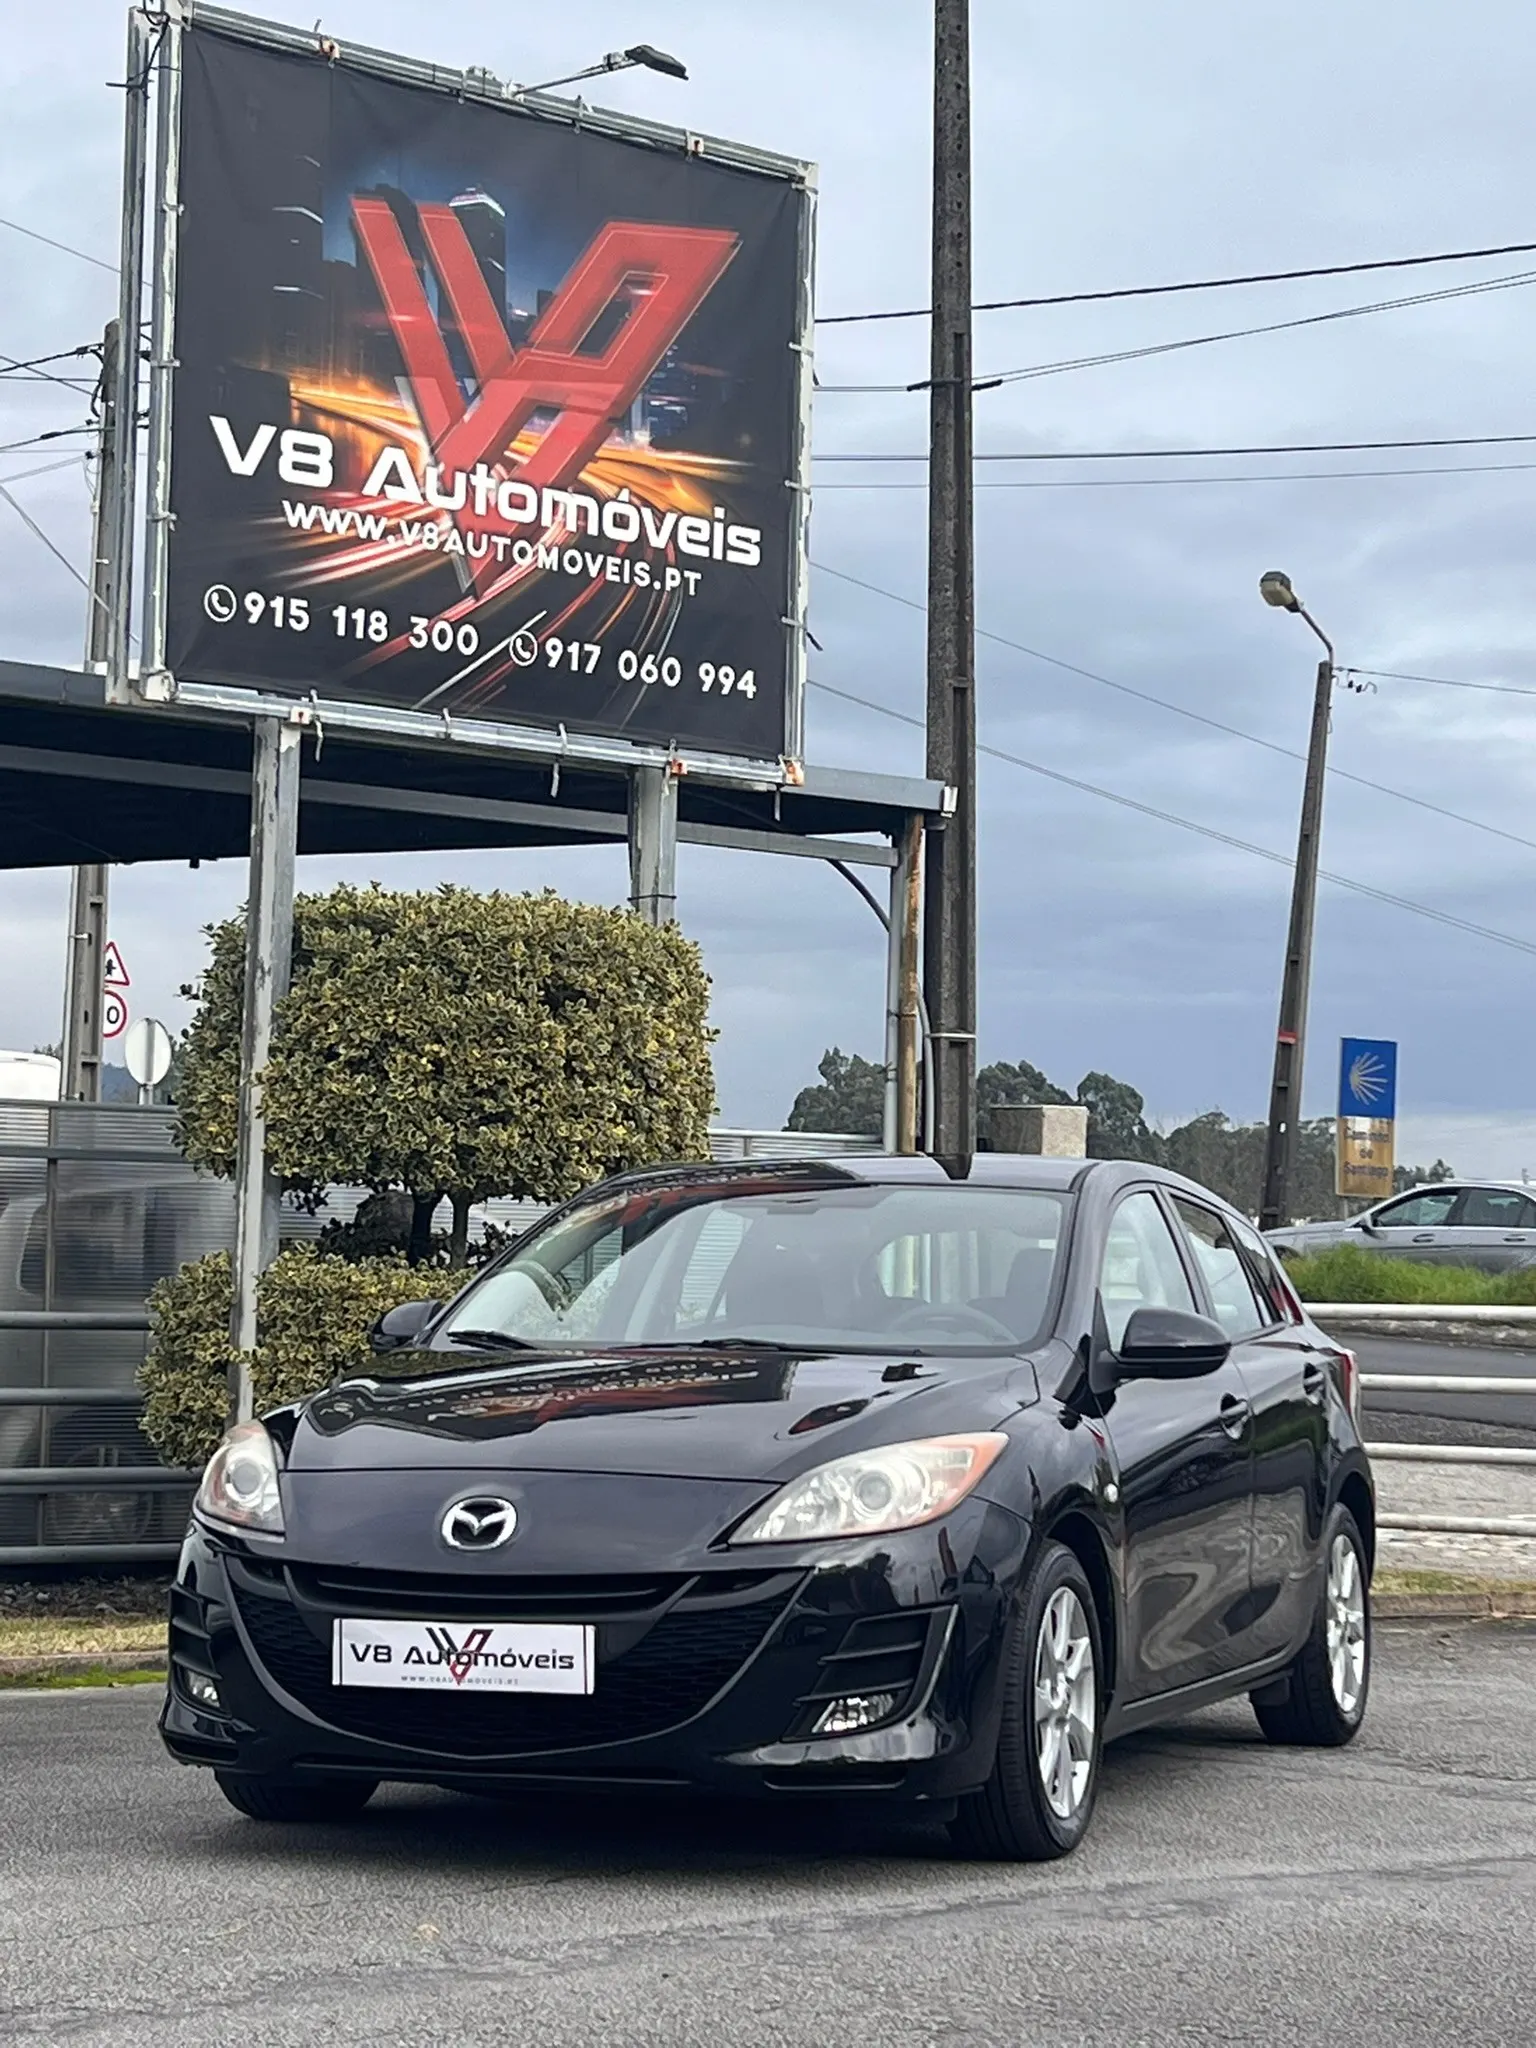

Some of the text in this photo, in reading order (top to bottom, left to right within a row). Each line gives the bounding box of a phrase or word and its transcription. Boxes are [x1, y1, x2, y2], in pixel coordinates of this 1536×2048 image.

[209, 415, 761, 566] V8 Automóveis
[281, 499, 702, 596] WWW.V8AUTOMOVEIS.PT
[243, 590, 479, 656] 915 118 300
[545, 637, 757, 699] 917 060 994
[349, 1643, 575, 1670] V8 Automóveis
